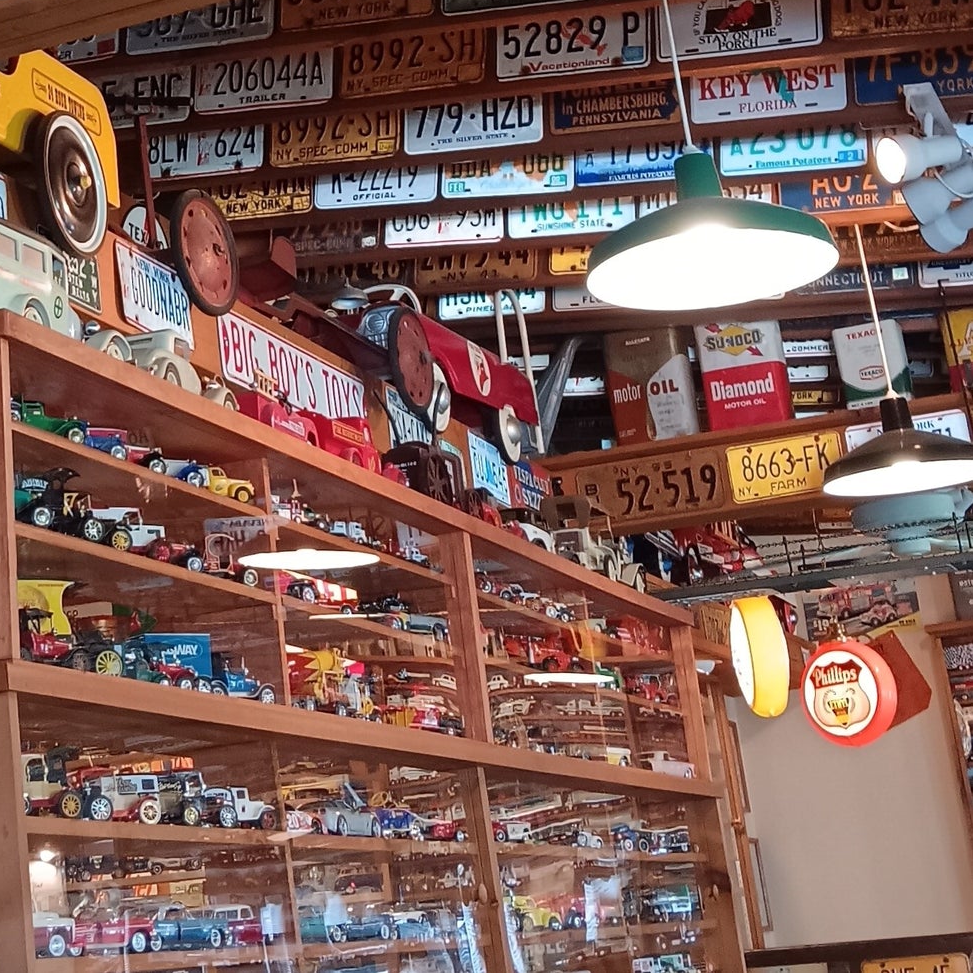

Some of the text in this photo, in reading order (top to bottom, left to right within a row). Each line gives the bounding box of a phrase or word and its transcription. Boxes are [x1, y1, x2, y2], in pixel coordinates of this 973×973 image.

[318, 0, 393, 21] NEW YORK
[502, 14, 608, 61] 52829
[698, 27, 777, 46] STAY ON THE
[717, 37, 760, 52] PORCH
[213, 50, 325, 97] 206044A
[527, 56, 612, 73] Vacationland
[698, 70, 753, 102] KEY
[761, 62, 838, 94] WEST
[238, 93, 287, 105] TRAILER
[562, 101, 573, 116] in
[738, 98, 798, 115] FLORIDA
[572, 107, 663, 127] PENNSYLVANIA
[213, 124, 257, 159] 624
[276, 148, 293, 162] NY
[754, 154, 832, 170] Famous Potatoes
[225, 199, 280, 214] NEW YORK
[352, 191, 397, 203] OFFICIAL
[814, 192, 879, 210] NEW YORK
[705, 329, 761, 351] SUNOCO
[231, 316, 364, 419] BIG BOY'S TOYS
[613, 378, 680, 405] motor OIL
[710, 372, 775, 403] Diamond
[724, 398, 767, 410] MOTOR OIL
[738, 477, 808, 498] NY FARM
[815, 665, 858, 687] Phillips
